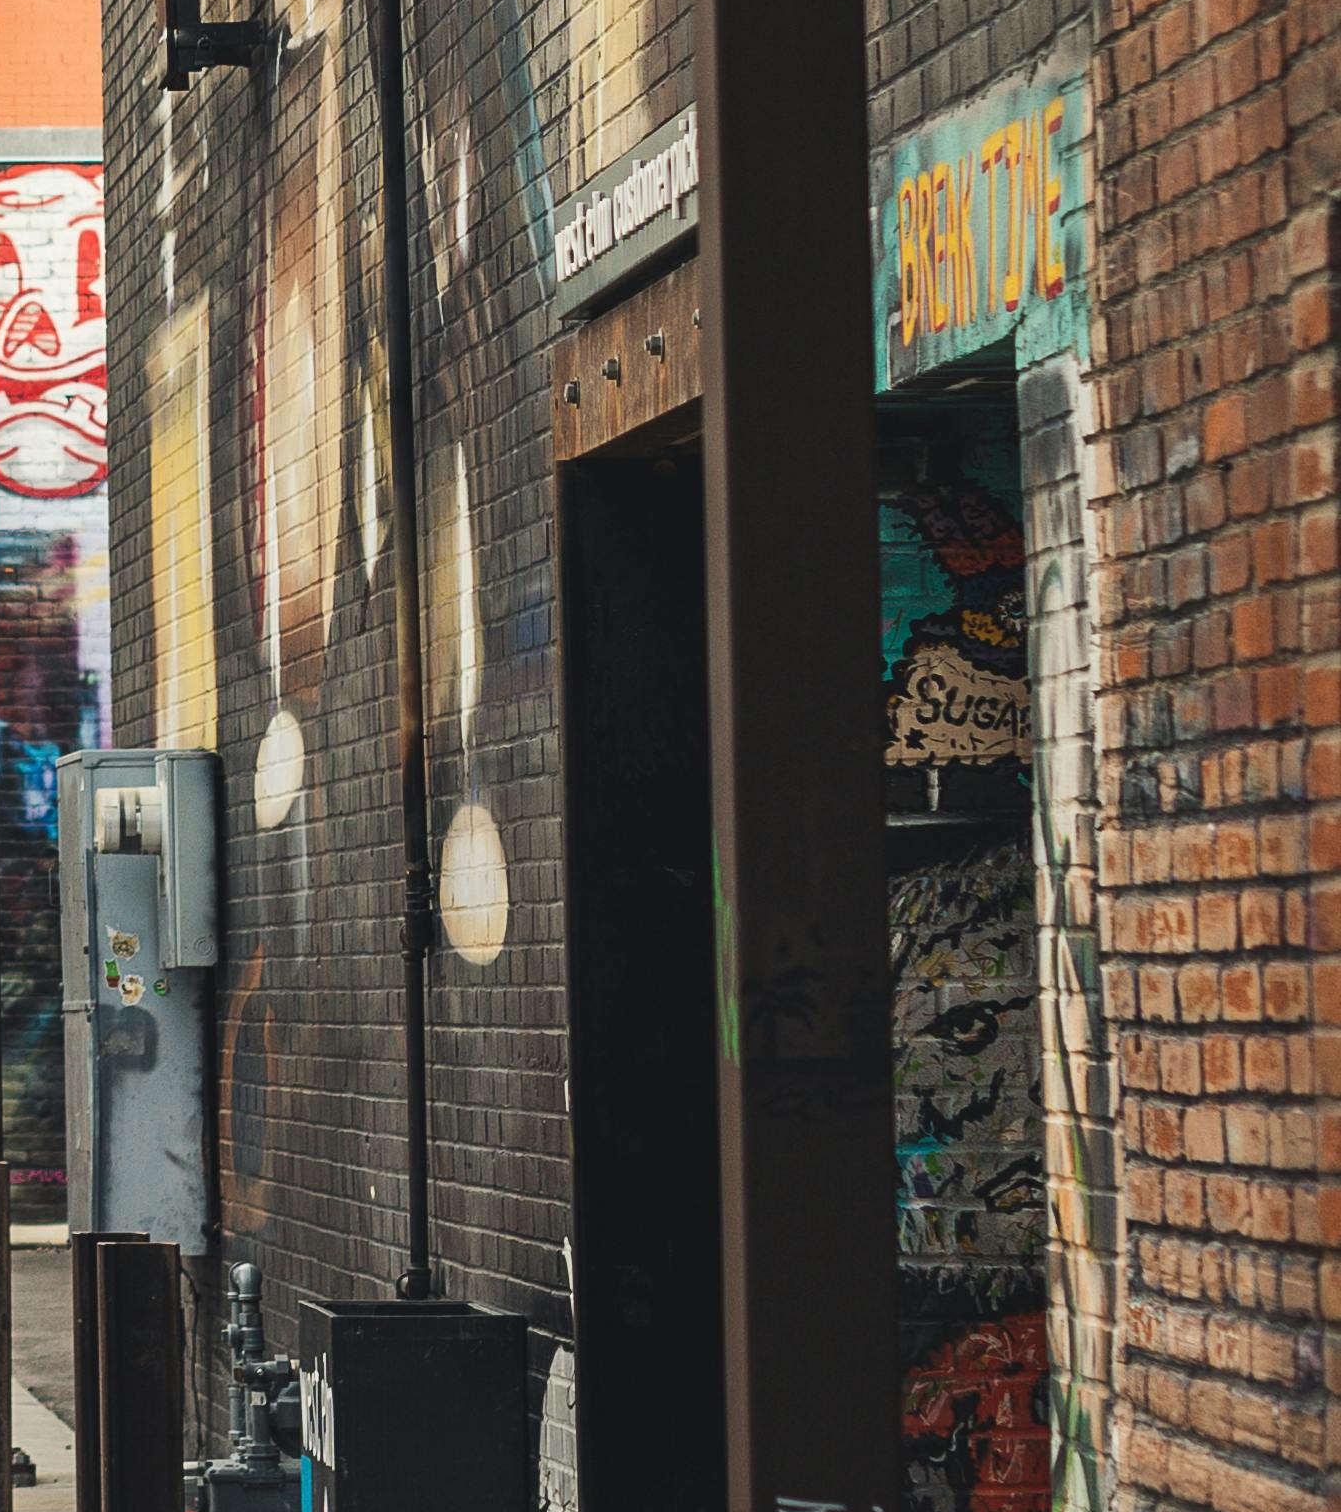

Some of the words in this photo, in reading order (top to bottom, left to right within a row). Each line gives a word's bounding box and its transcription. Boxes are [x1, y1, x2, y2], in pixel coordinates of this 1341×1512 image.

[613, 159, 672, 240] customer
[898, 149, 977, 347] BREAK
[981, 96, 1066, 312] TIME
